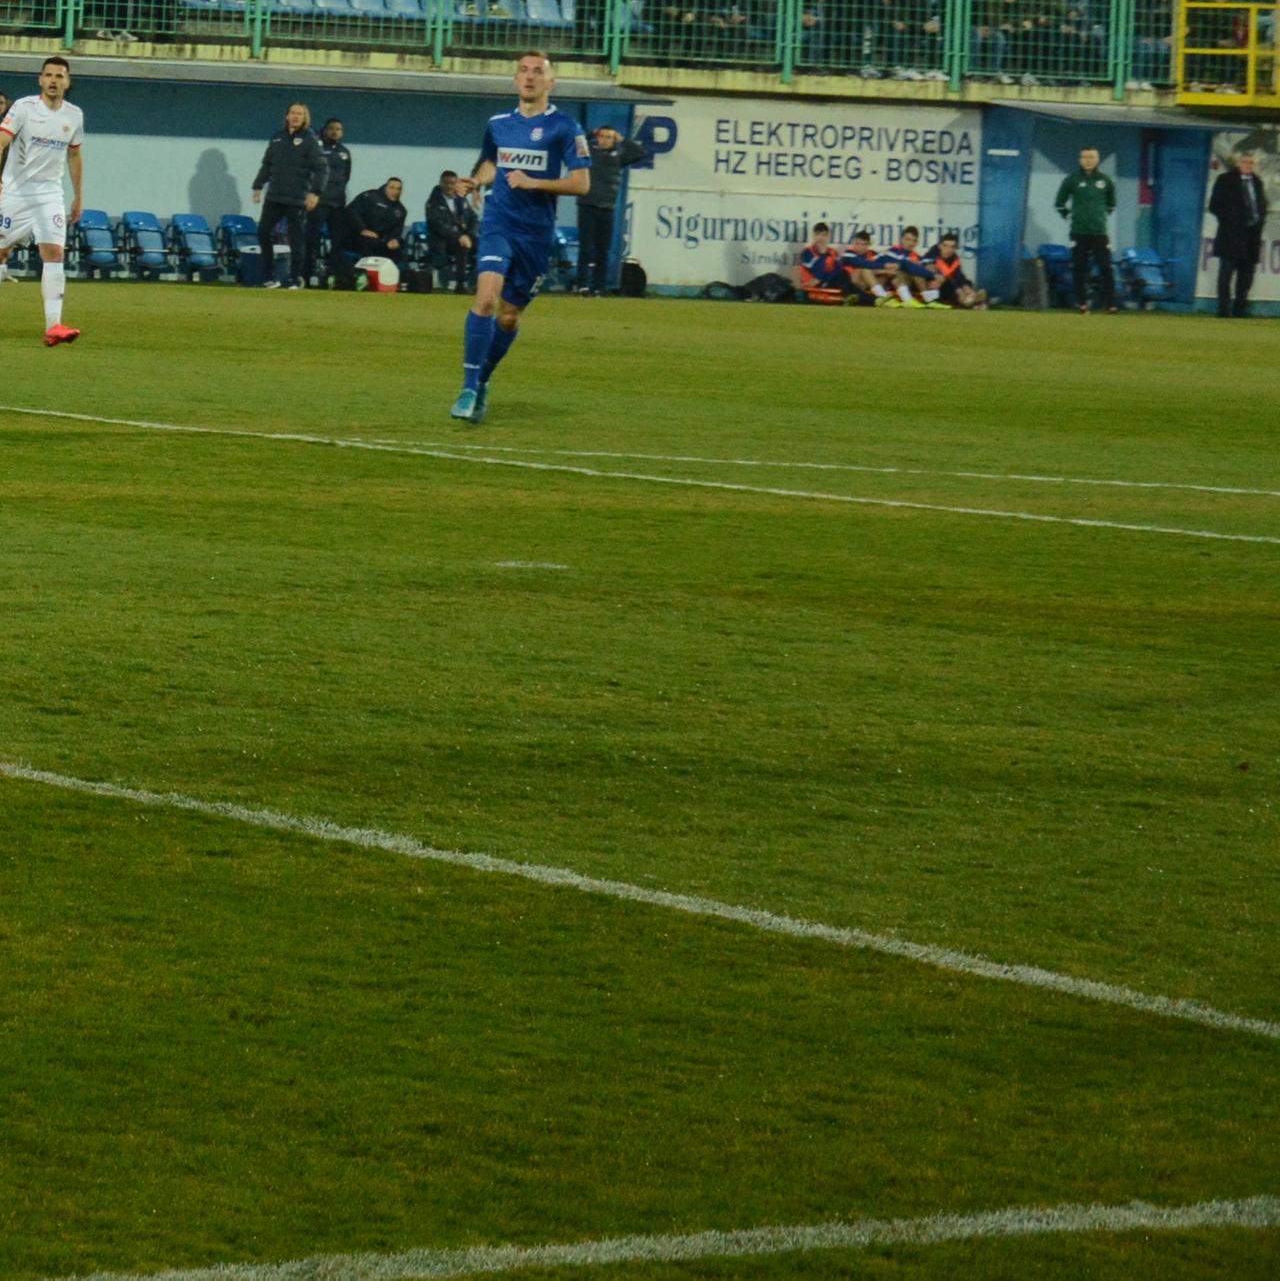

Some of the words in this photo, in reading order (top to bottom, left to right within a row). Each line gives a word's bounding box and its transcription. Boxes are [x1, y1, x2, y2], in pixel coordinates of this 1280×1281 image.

[715, 119, 974, 156] ELEKTROPRIVREDA
[714, 150, 747, 174] HZ
[755, 152, 862, 180] HERCEG
[885, 157, 976, 185] BOSNE
[655, 205, 809, 248] Sigurnosni
